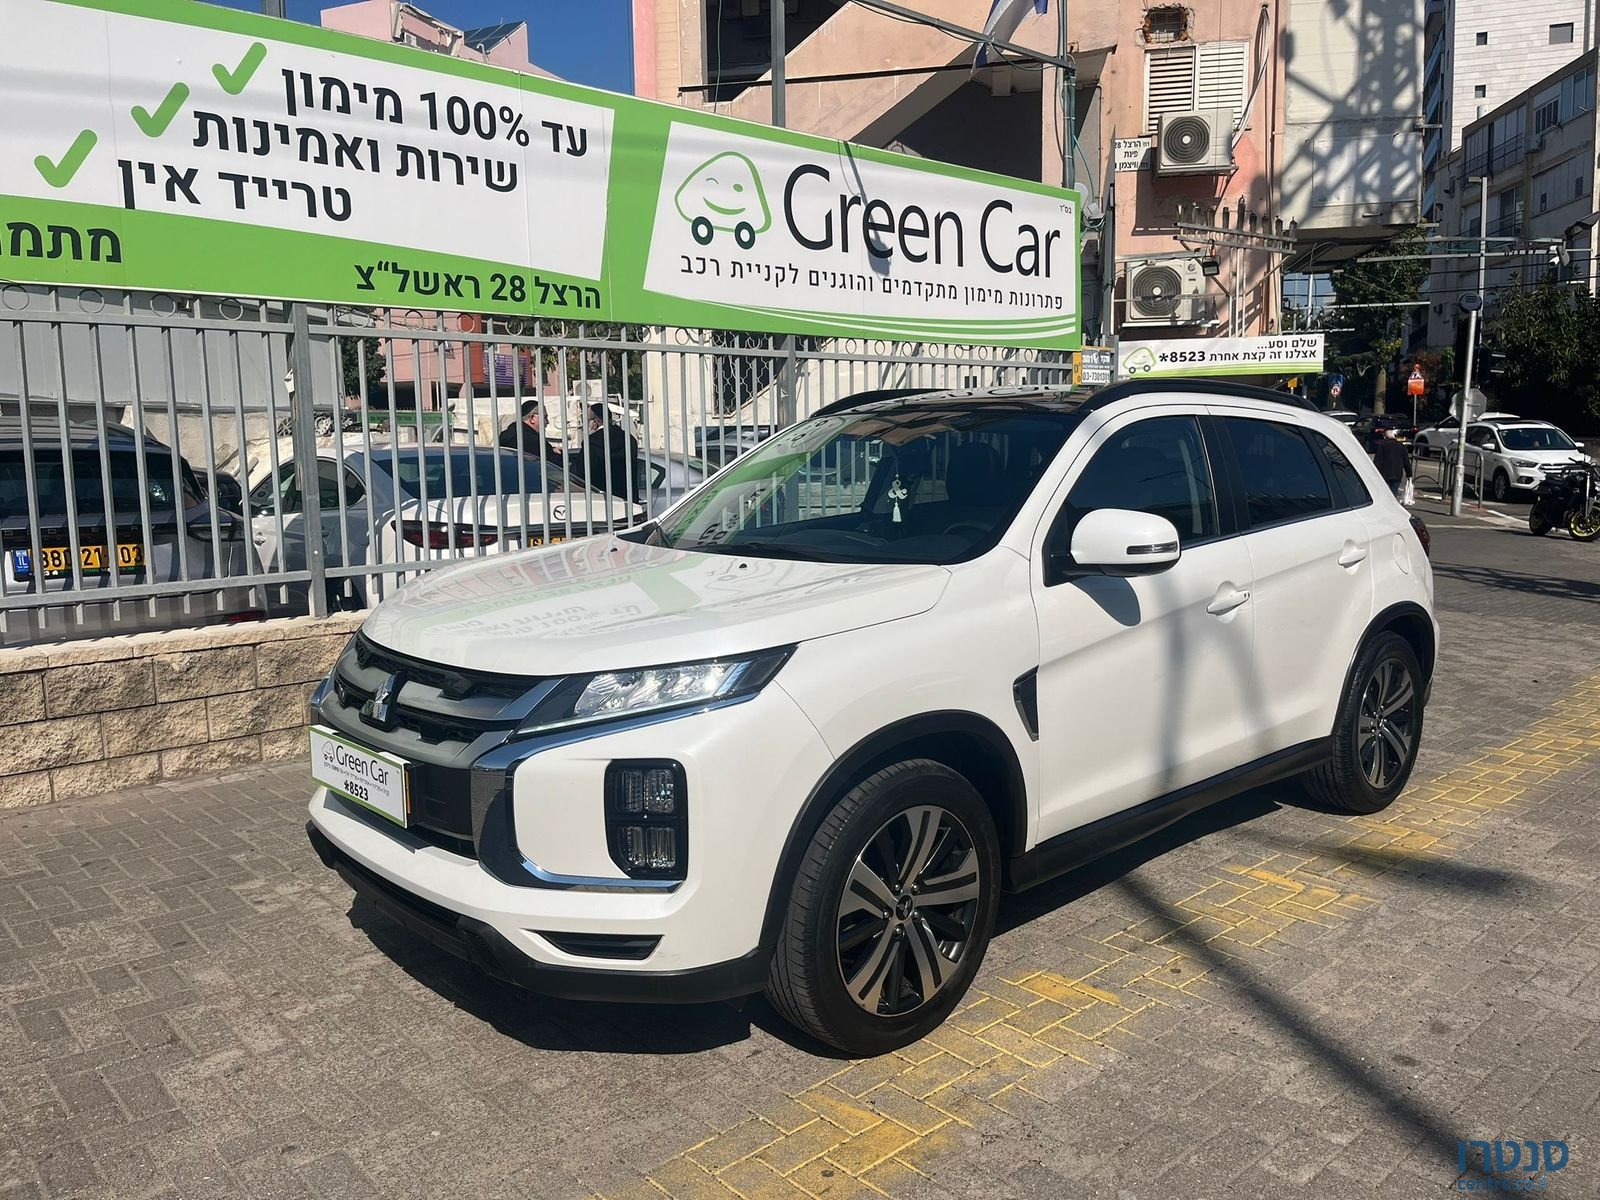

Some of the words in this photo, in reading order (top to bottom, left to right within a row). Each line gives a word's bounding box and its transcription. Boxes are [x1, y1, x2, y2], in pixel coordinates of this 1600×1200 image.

[281, 68, 403, 126] מימון
[420, 91, 530, 148] 100%
[193, 110, 381, 173] ואמינות
[542, 119, 588, 158] עד
[1123, 140, 1141, 148] הרצל
[396, 142, 518, 193] שירות
[1124, 150, 1138, 158] פינת
[117, 158, 201, 210] אין
[218, 171, 352, 222] טרייד
[783, 164, 964, 268] Green
[979, 200, 1061, 278] Car
[0, 222, 122, 263] מתמ
[680, 254, 720, 276] רכב
[730, 260, 799, 288] לקניית
[489, 272, 526, 303] 28
[534, 275, 601, 309] הרצל
[809, 269, 874, 292] והוגנים
[882, 277, 957, 302] מתקדמים
[964, 287, 1004, 306] מימון
[1009, 289, 1064, 311] פתרונות
[1209, 351, 1239, 361] אחרת
[1242, 351, 1266, 362] קצת
[1269, 351, 1281, 359] זה
[1285, 349, 1317, 359] אצלנו
[1291, 337, 1317, 348] שלם
[336, 745, 368, 776] Green
[370, 760, 389, 786] Car
